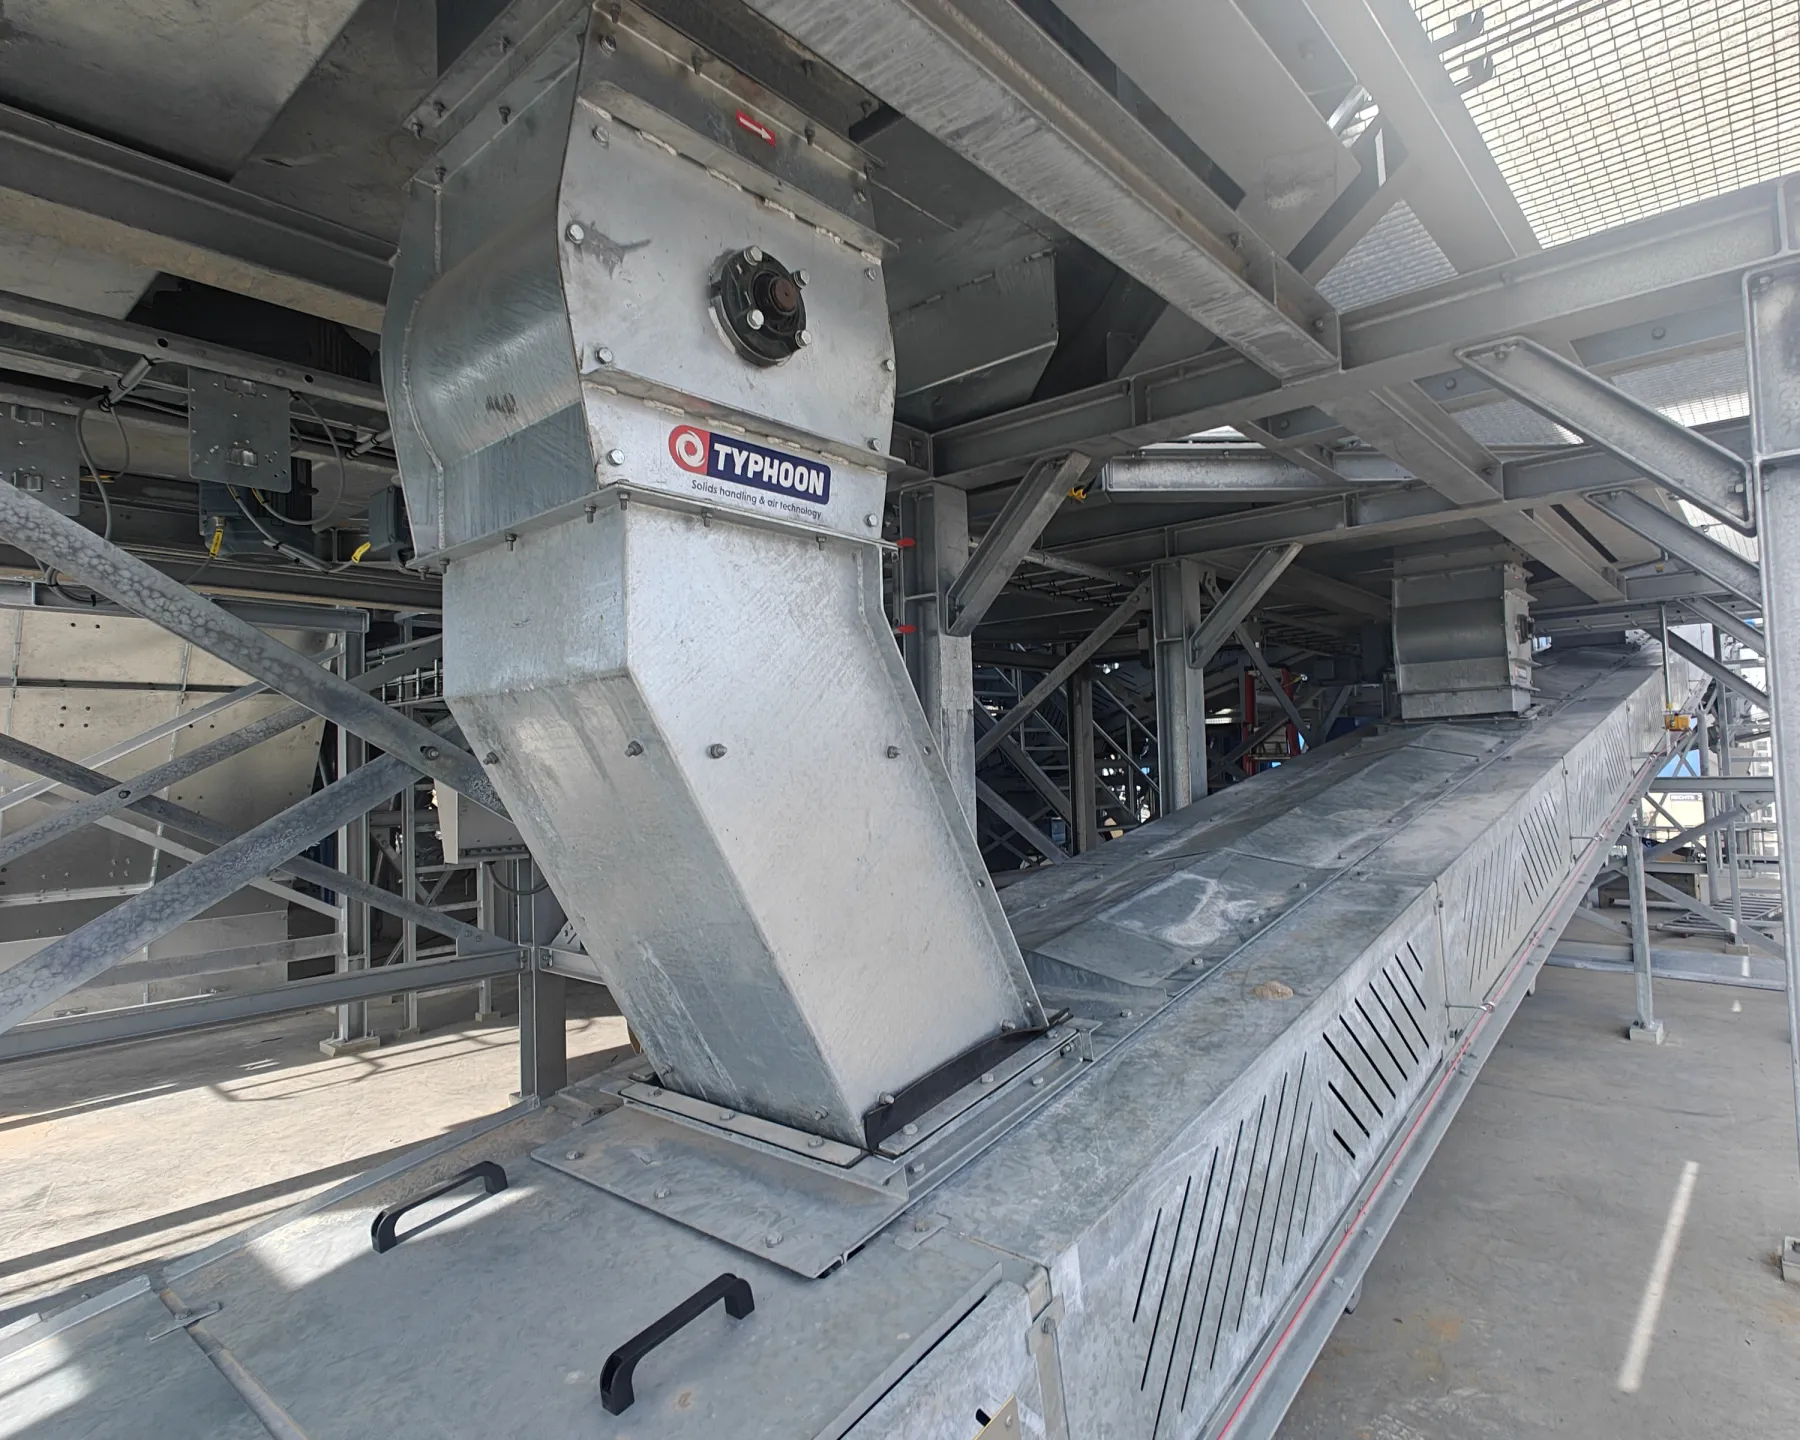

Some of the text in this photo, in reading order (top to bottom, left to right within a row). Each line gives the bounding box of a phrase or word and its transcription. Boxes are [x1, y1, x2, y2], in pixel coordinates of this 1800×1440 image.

[713, 443, 825, 497] TYPHOON
[691, 479, 822, 520] Solids handling & air technology
